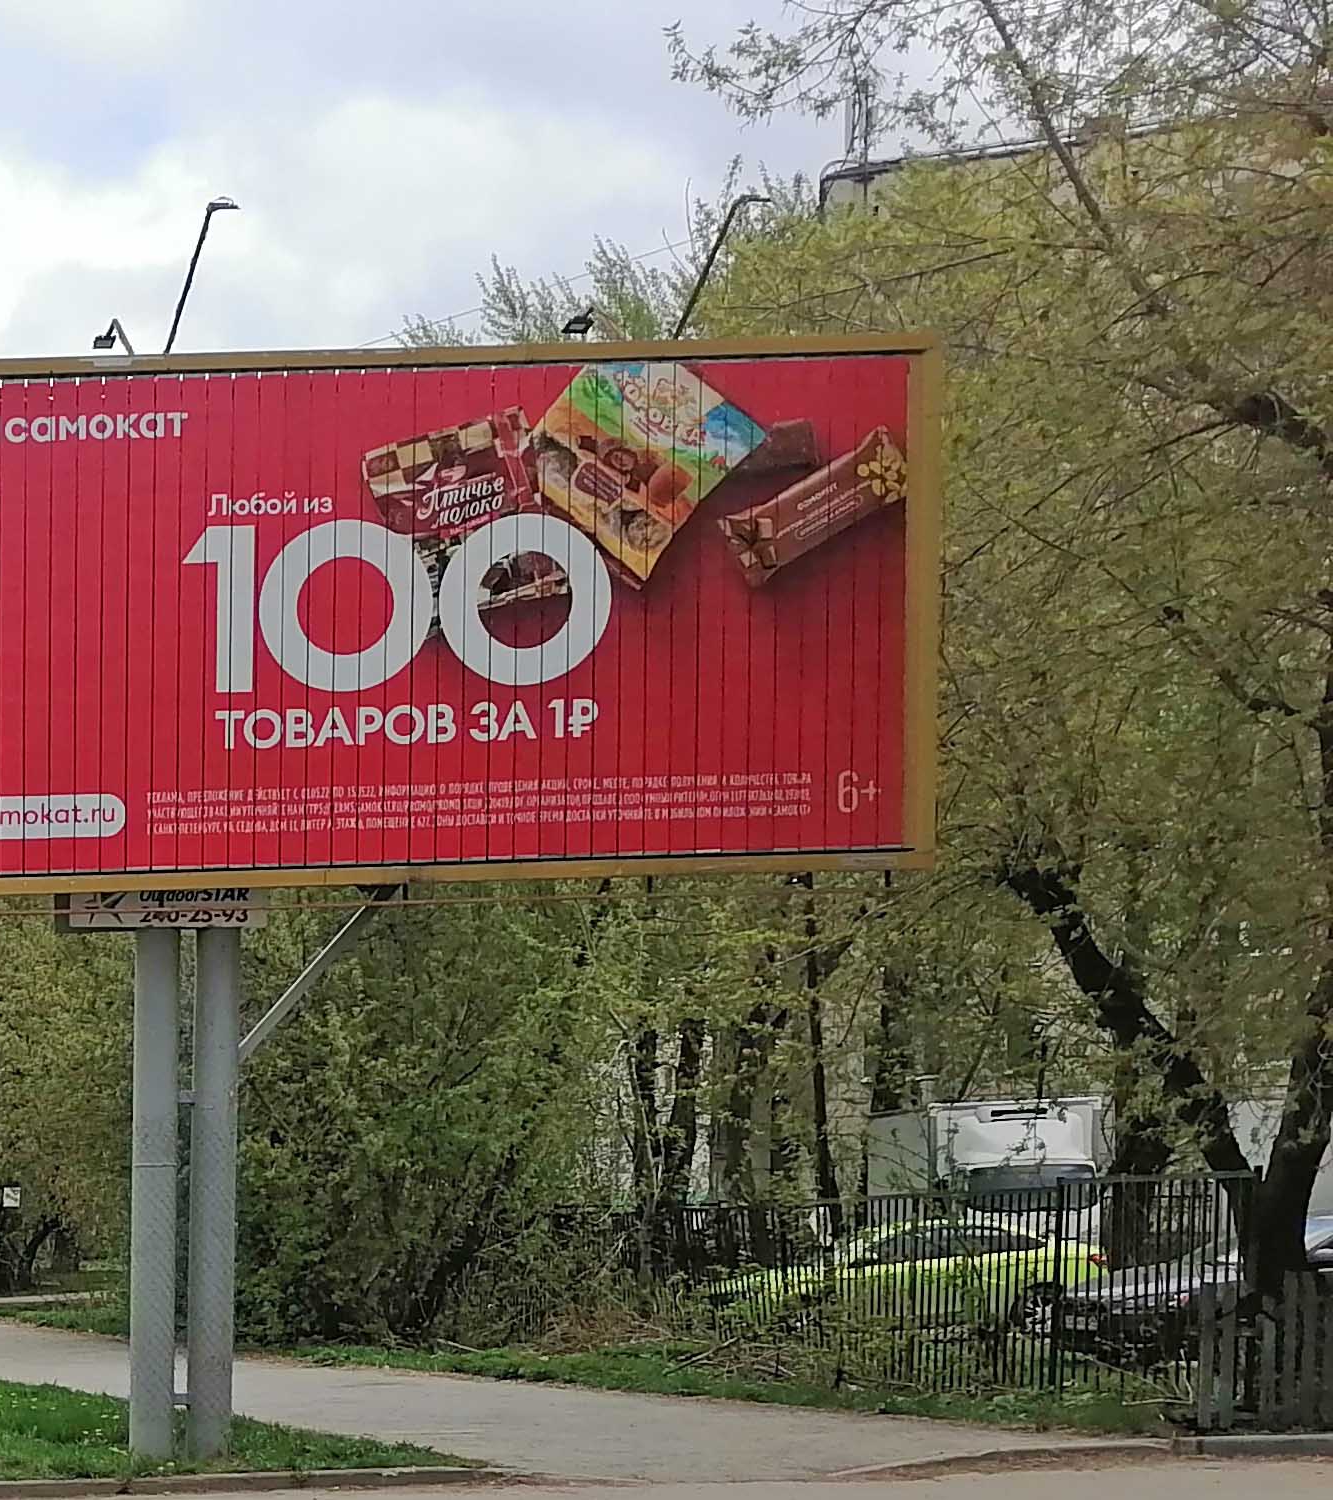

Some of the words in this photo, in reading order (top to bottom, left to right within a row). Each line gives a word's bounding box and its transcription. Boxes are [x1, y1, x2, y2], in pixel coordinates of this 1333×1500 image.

[4, 410, 189, 443] самокат
[207, 491, 298, 518] Любой
[302, 495, 334, 515] из
[416, 473, 505, 521] Птичье
[430, 492, 505, 529] молоко
[180, 512, 613, 694] 100
[214, 703, 457, 750] ТОВАРОВ
[468, 699, 537, 743] ЗА
[837, 769, 882, 813] 6+
